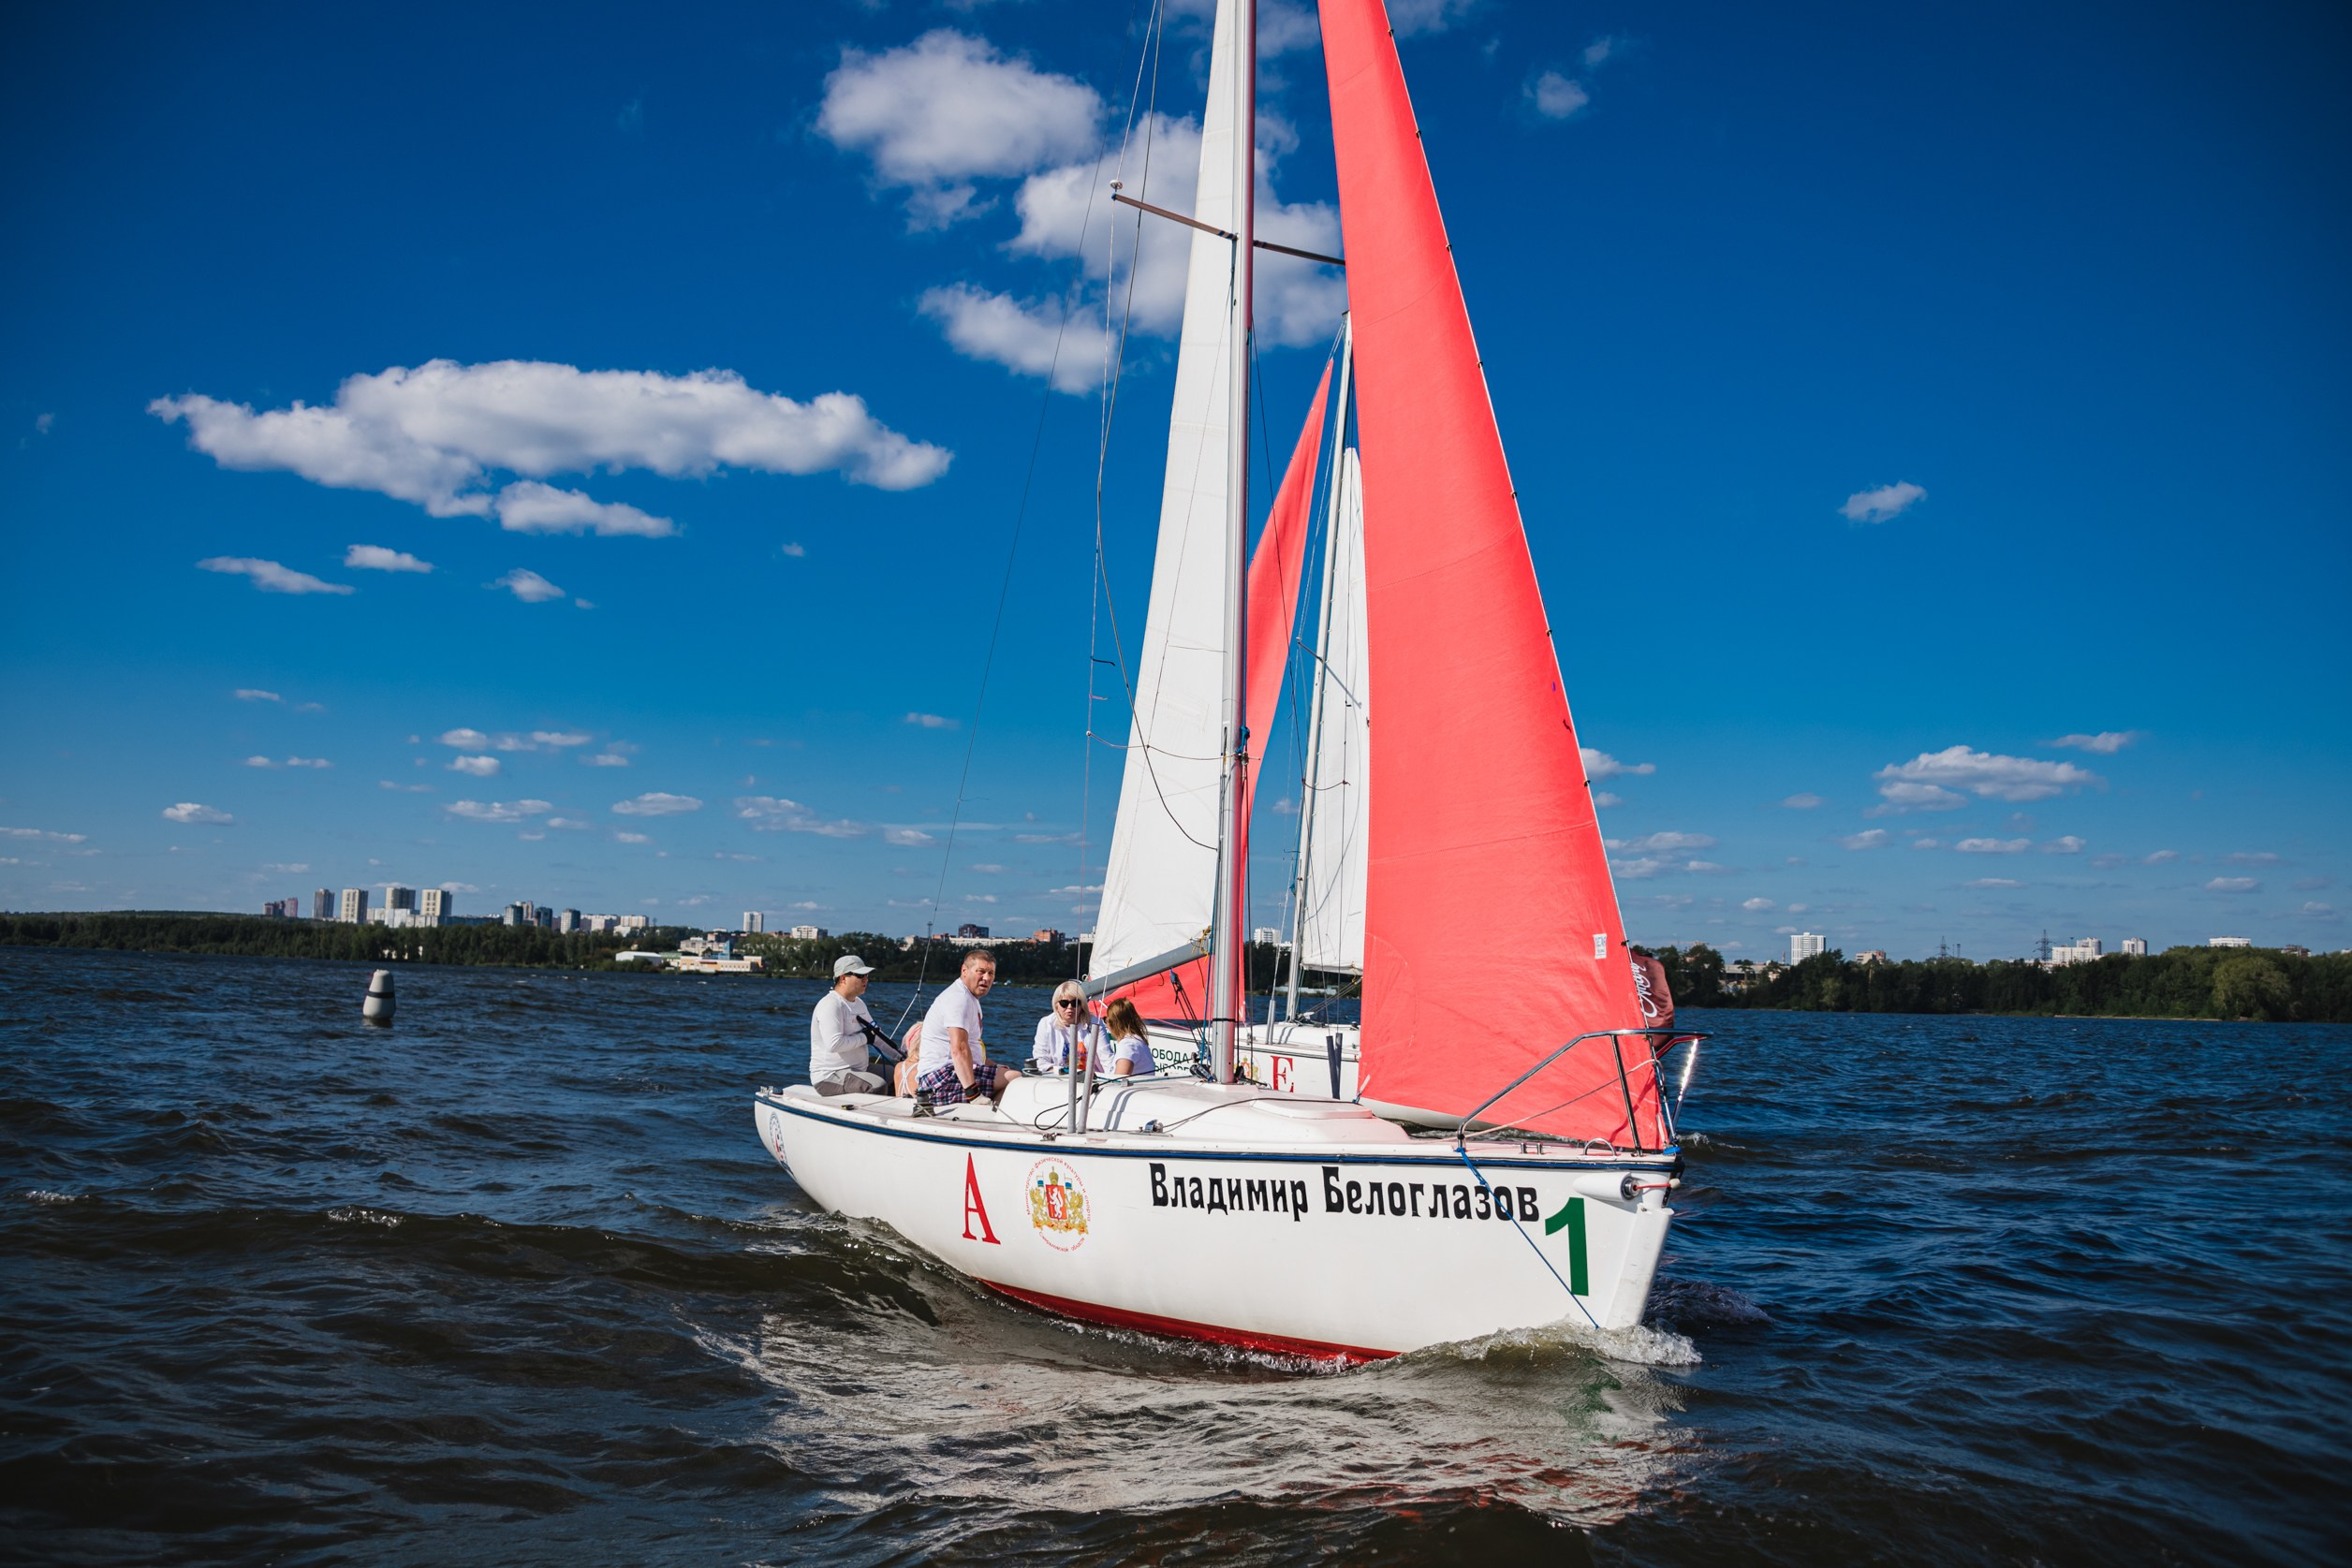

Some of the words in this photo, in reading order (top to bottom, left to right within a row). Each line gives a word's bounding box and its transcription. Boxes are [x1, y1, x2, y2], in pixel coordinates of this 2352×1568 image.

[963, 1151, 1001, 1245] А
[1149, 1163, 1308, 1222] Владимир
[1321, 1165, 1539, 1222] Белоглазов
[1545, 1197, 1589, 1297] 1
